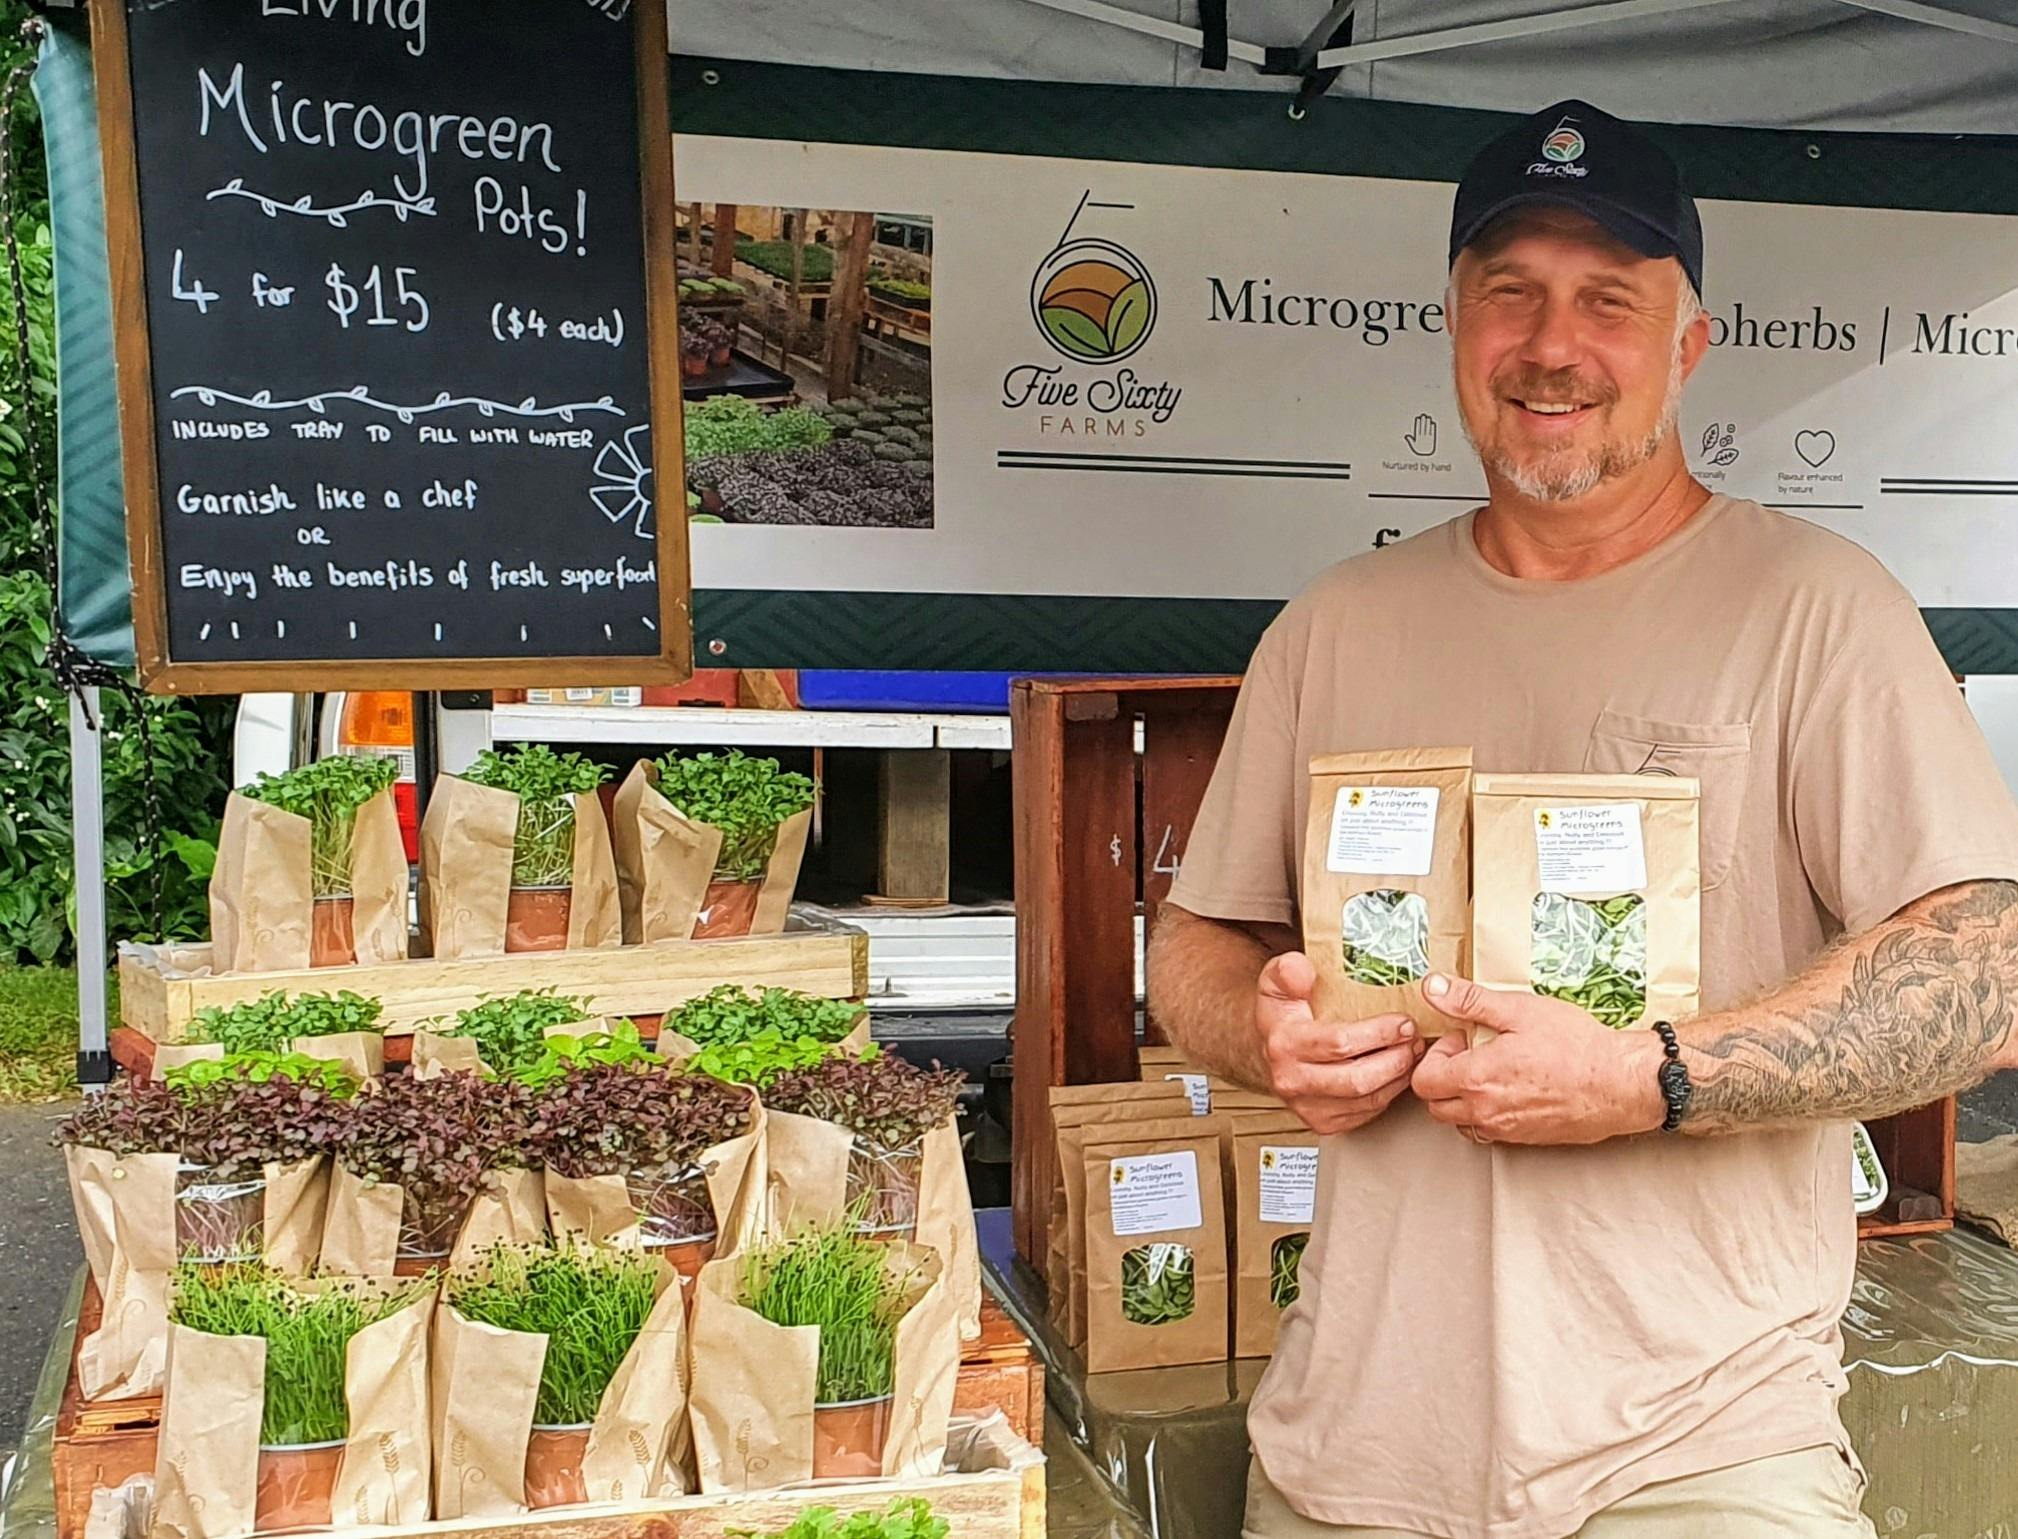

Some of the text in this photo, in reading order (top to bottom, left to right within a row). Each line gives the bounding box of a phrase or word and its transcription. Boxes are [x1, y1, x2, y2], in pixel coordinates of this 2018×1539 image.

[199, 63, 561, 200] Microgreen
[475, 177, 585, 256] Pots!
[173, 249, 623, 346] 4 for $15 ($4 each)
[1913, 313, 2018, 355] Micr
[1002, 365, 1182, 425] Five Sixty
[173, 420, 593, 448] INCLUDES TRAY TO FILL WITH WATER
[1041, 412, 1145, 437] FARMS
[178, 480, 477, 514] Garnish like a chef
[298, 527, 330, 544] OR
[181, 556, 655, 599] Enjoy the benefits of fresh superfood
[1560, 809, 1611, 819] Sunflower
[1561, 820, 1623, 831] Microgreens
[1110, 833, 1122, 867] $
